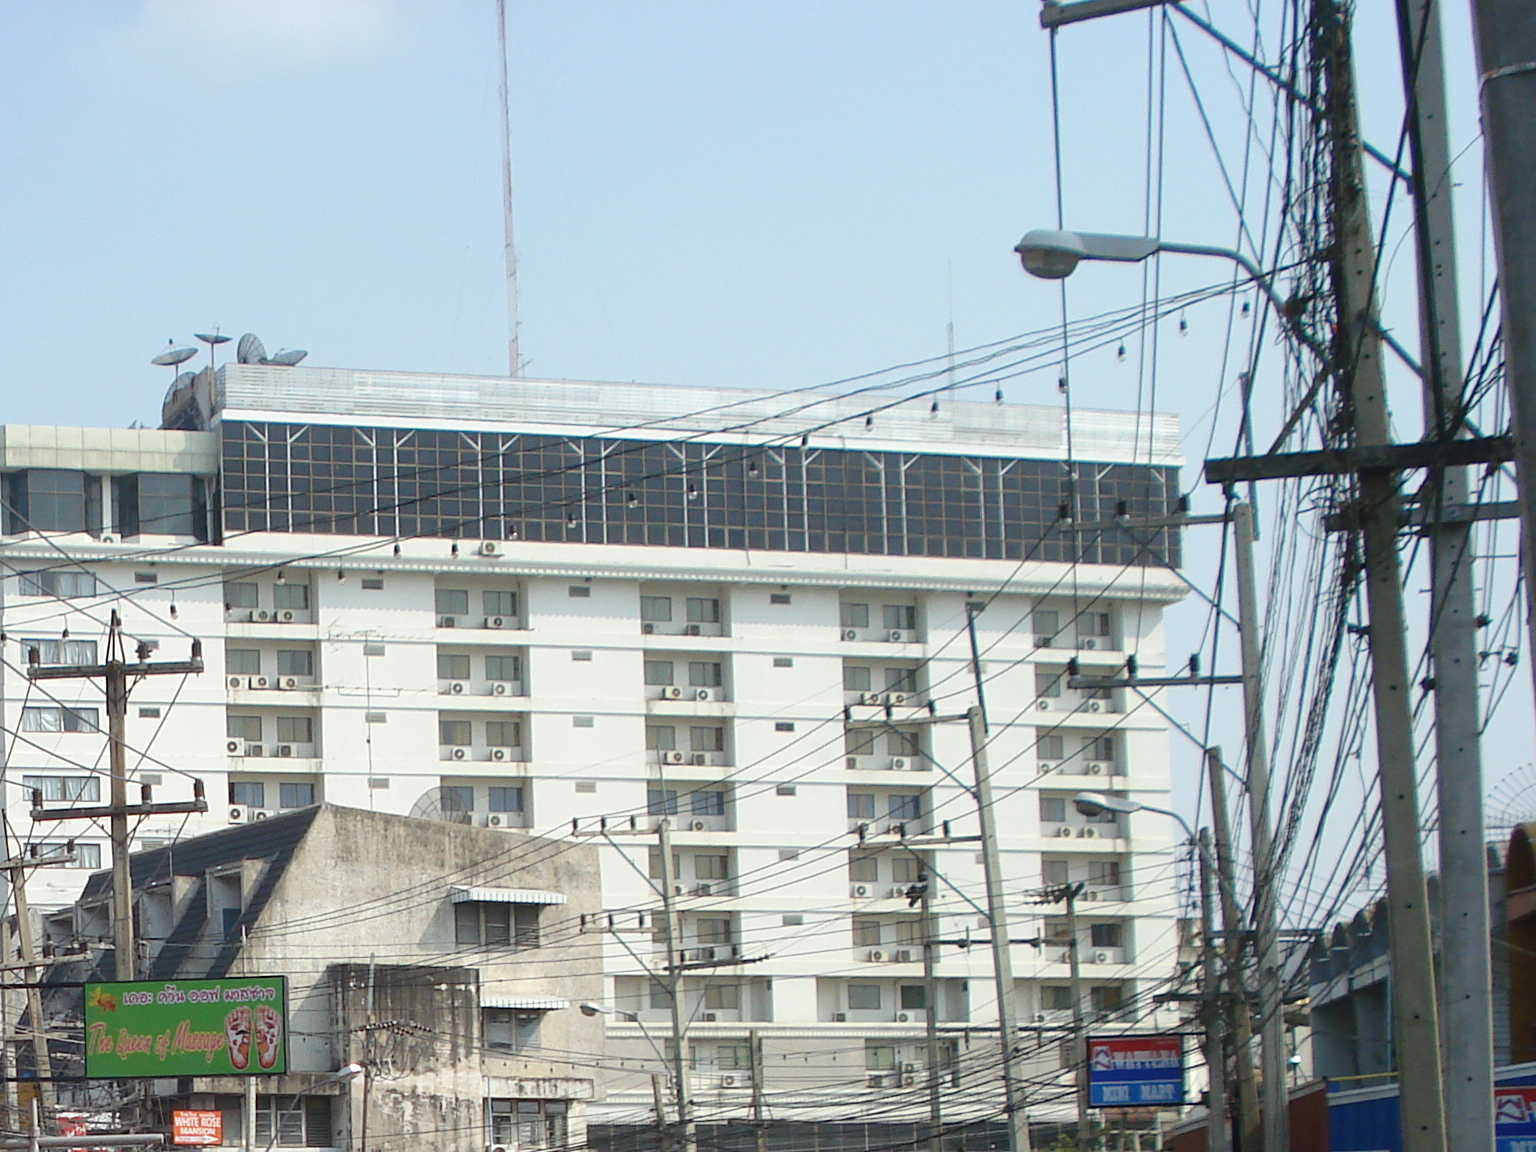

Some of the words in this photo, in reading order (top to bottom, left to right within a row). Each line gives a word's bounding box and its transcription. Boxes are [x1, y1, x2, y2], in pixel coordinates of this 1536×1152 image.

[87, 1021, 113, 1056] The
[116, 1028, 152, 1060] Queen
[155, 1029, 172, 1061] of
[171, 1019, 226, 1063] Massage
[1140, 1084, 1174, 1100] MART
[174, 1117, 200, 1127] WHITE
[201, 1117, 222, 1127] ROSE
[180, 1127, 216, 1135] MANSION
